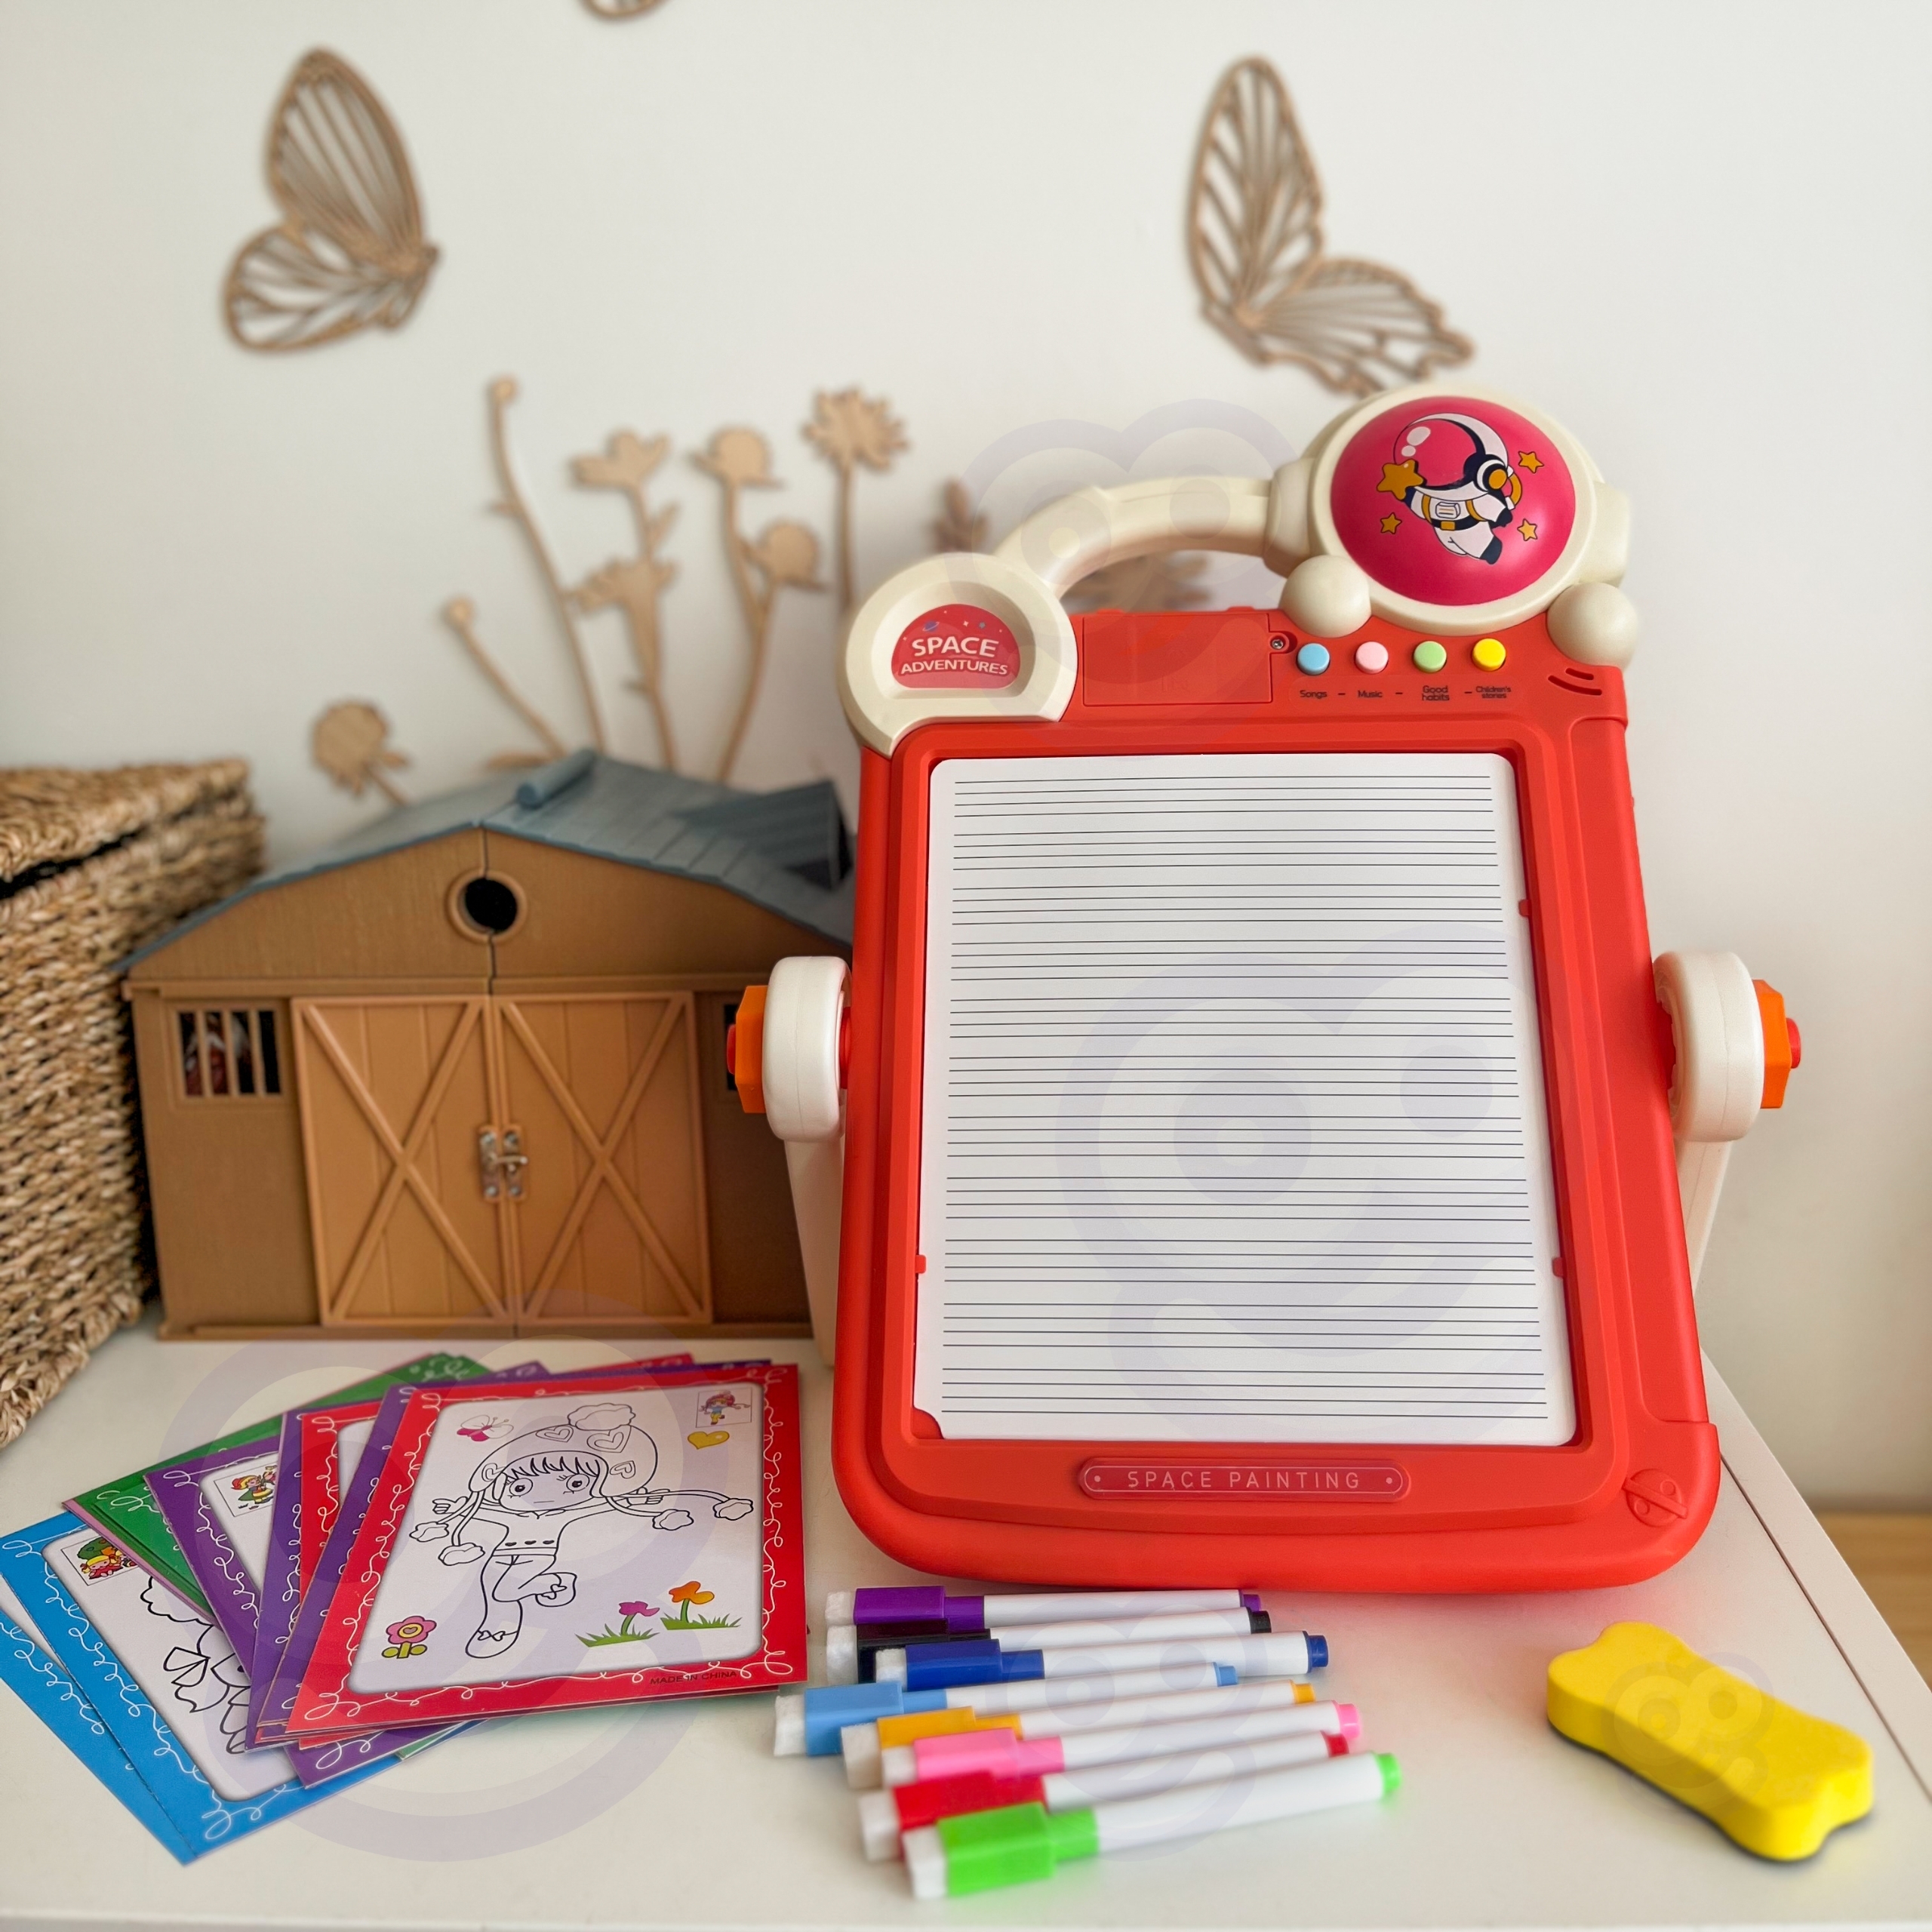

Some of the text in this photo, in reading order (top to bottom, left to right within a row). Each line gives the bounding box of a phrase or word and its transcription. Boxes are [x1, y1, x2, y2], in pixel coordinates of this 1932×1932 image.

[912, 635, 999, 658] SPACE
[900, 659, 1008, 675] ADVENTURES
[1300, 690, 1327, 699] Songs
[1422, 685, 1448, 694] Good
[1422, 692, 1450, 701] habits
[1127, 1470, 1359, 1489] SPACE PAINTING
[651, 1675, 682, 1684] MADE
[702, 1671, 737, 1680] CHINA
